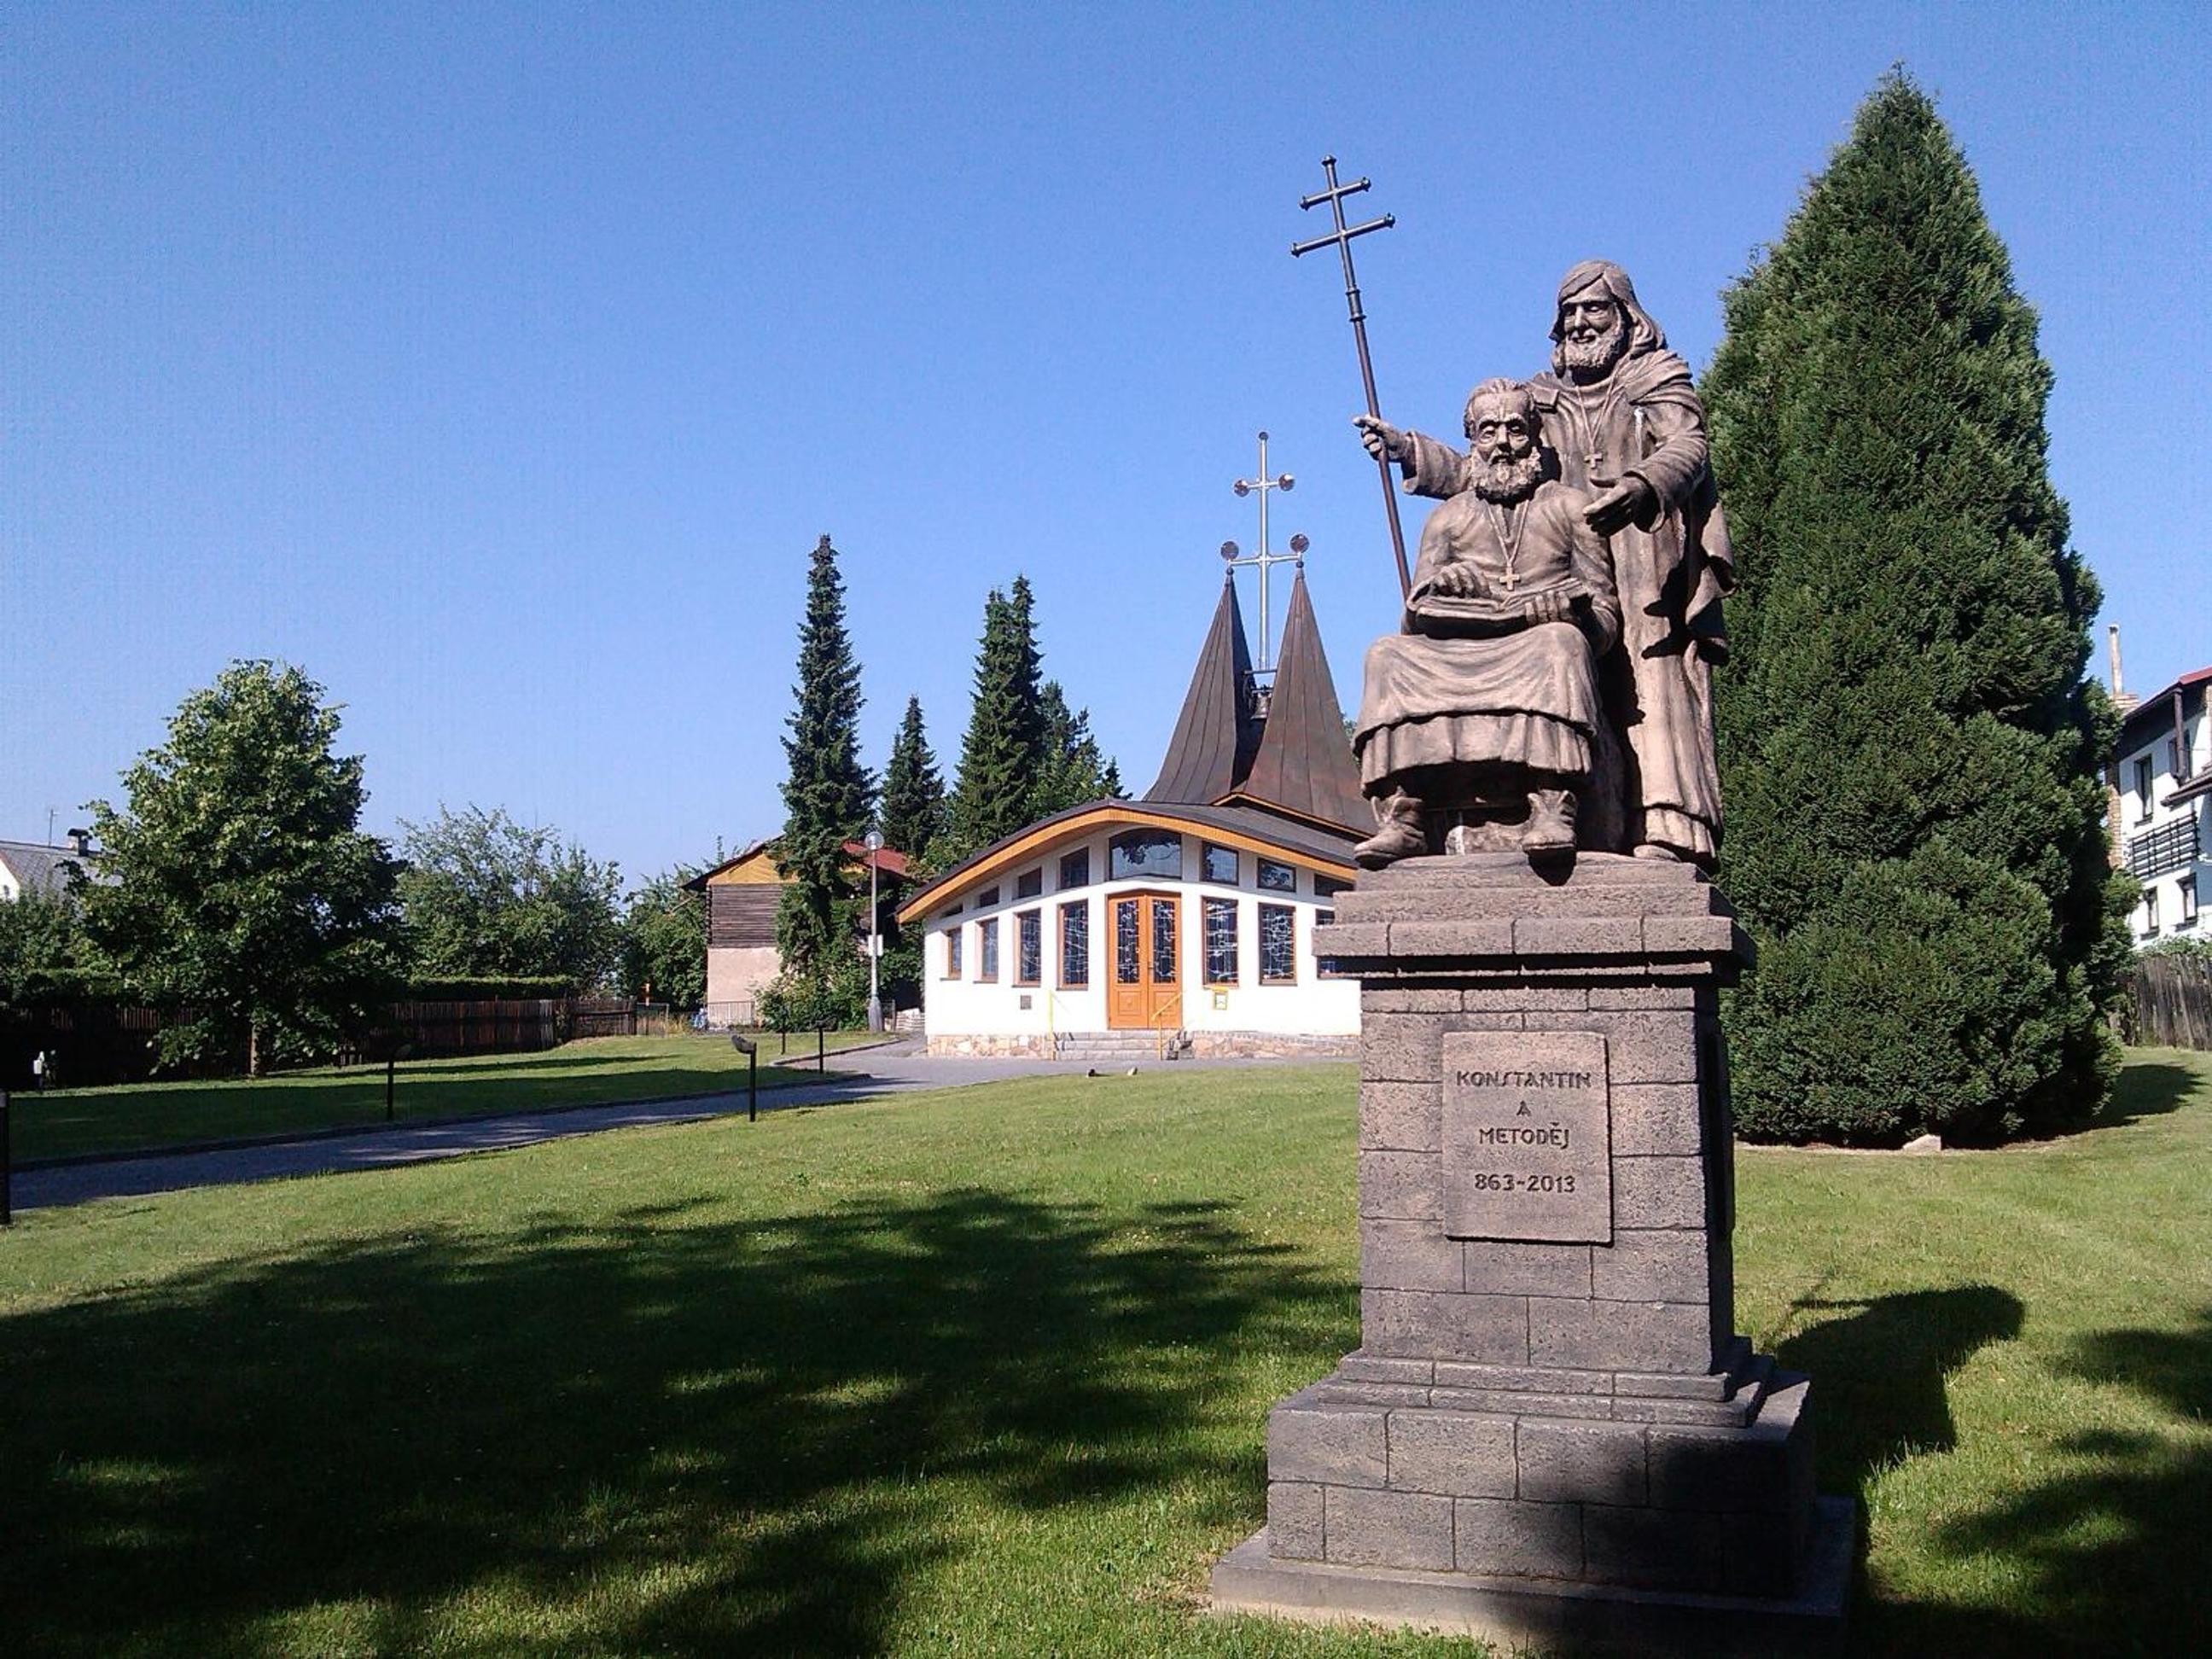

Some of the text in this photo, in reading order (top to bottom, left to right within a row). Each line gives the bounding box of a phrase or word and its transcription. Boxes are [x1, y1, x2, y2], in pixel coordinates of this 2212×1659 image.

[1457, 1070, 1592, 1089] KONSTANTIN
[1516, 1100, 1532, 1116] A
[1478, 1121, 1570, 1150] METODĚJ
[1474, 1173, 1576, 1193] 863-2013
